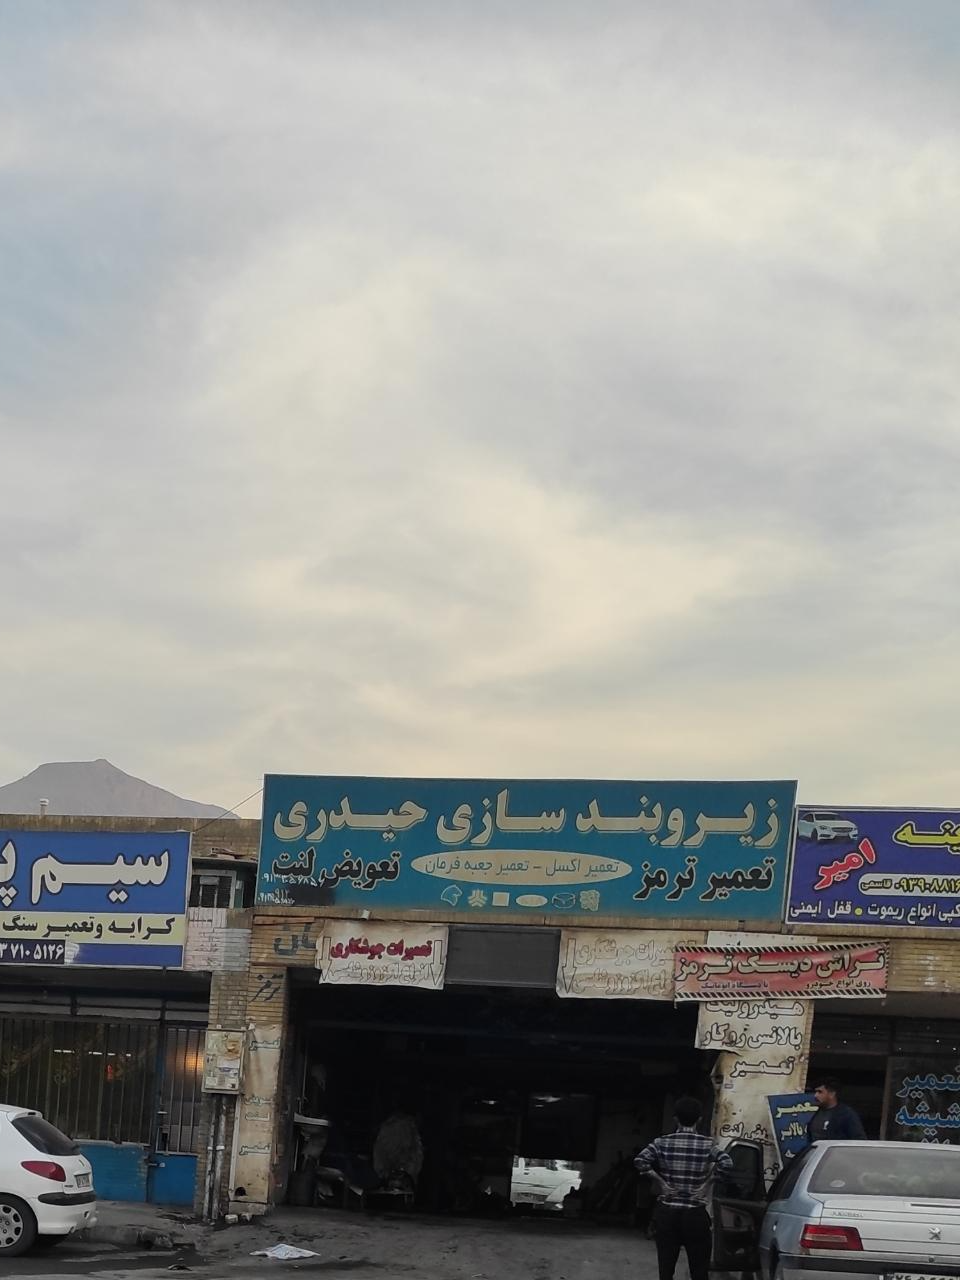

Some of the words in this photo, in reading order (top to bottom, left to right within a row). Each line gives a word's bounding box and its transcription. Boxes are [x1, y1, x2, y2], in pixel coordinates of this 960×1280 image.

[273, 796, 430, 842] حیدری
[436, 787, 568, 847] سازی
[271, 846, 317, 880] لنت
[320, 849, 402, 891] تعویض
[424, 856, 461, 875] فرمان
[464, 860, 493, 875] جعبه
[495, 860, 529, 876] تعمیر
[545, 858, 581, 876] اکسل
[584, 861, 620, 878] تعمیر
[814, 837, 876, 891] امیر
[31, 850, 170, 905] سیم
[632, 855, 700, 901] ترمز
[699, 856, 776, 902] تعمیر
[790, 900, 822, 917] ایمنی
[827, 900, 852, 918] قفل
[867, 903, 905, 920] ریموت
[907, 902, 937, 925] انواع
[2, 915, 38, 932] سنگ
[108, 917, 176, 940] کرایه
[674, 953, 734, 982] ترمز
[737, 953, 813, 979] دیسک
[817, 948, 886, 979] تراش
[747, 1026, 803, 1050] بالانس
[730, 1056, 796, 1078] تعمیر
[896, 1065, 960, 1098] عمیر
